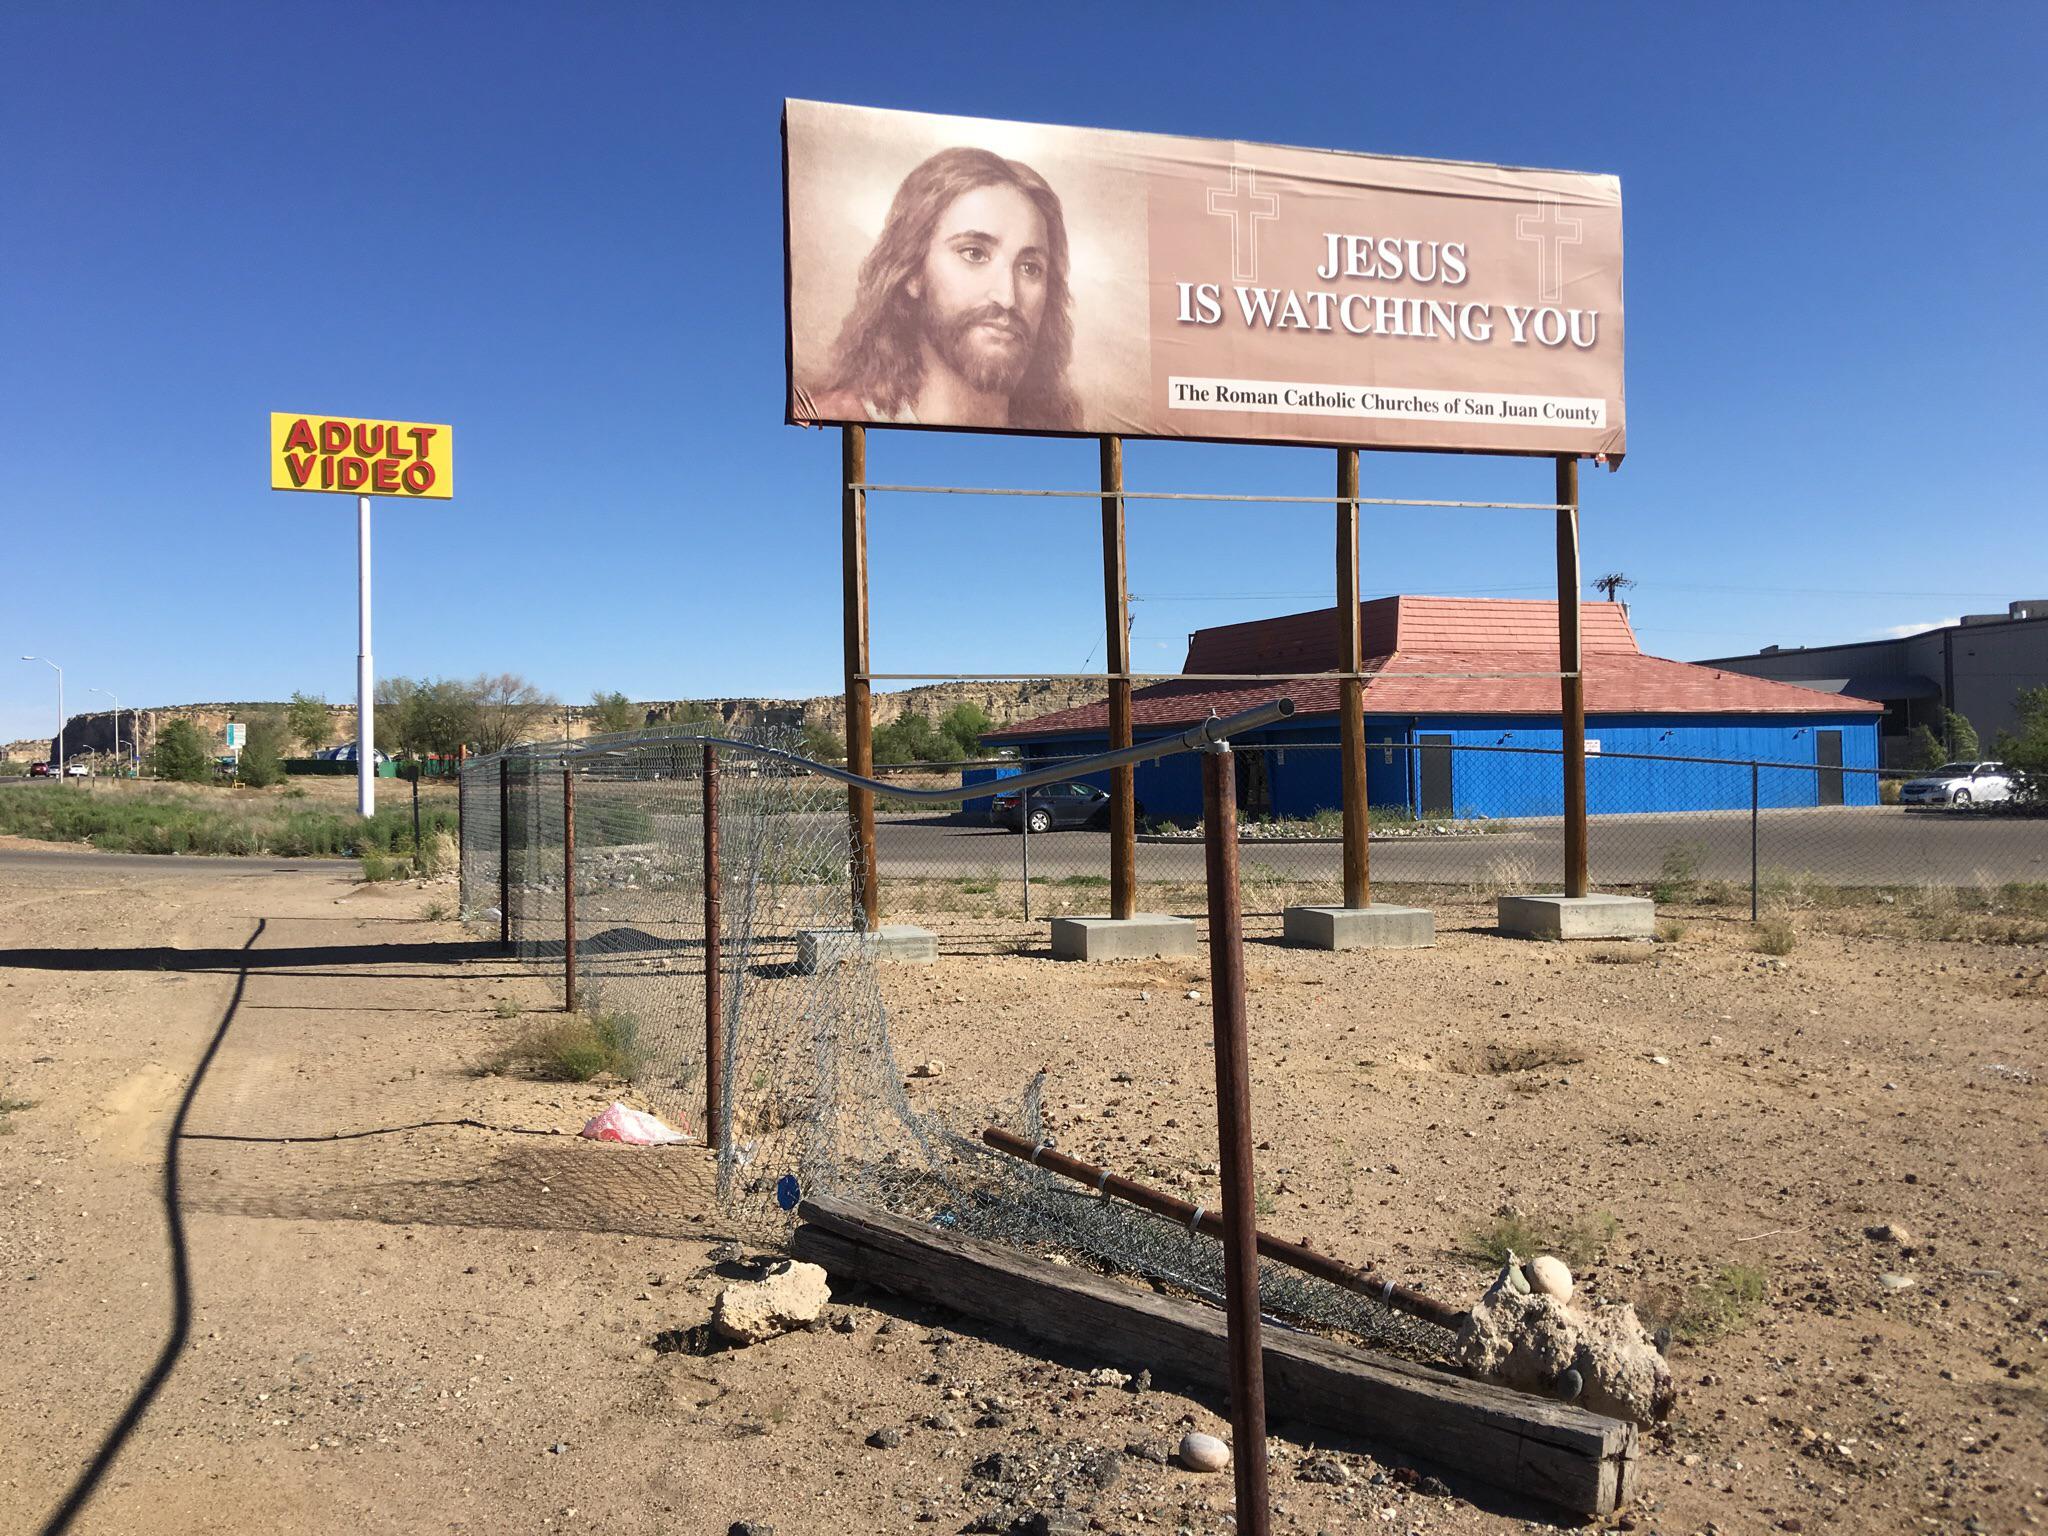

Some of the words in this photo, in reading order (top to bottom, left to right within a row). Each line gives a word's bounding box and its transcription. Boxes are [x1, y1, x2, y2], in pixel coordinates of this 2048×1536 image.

[1317, 233, 1467, 284] JESUS
[1177, 283, 1222, 324] IS
[1234, 286, 1493, 341] WATCHING
[1504, 305, 1598, 347] YOU
[1175, 383, 1210, 402] The
[1215, 385, 1278, 406] Roman
[1284, 389, 1356, 409] Catholic
[1361, 393, 1439, 414] Churches
[1444, 398, 1461, 414] of
[1465, 399, 1495, 417] San
[1499, 401, 1538, 419] Juan
[1543, 403, 1600, 424] County
[282, 418, 437, 461] ADULT
[284, 452, 436, 494] VIDEO
